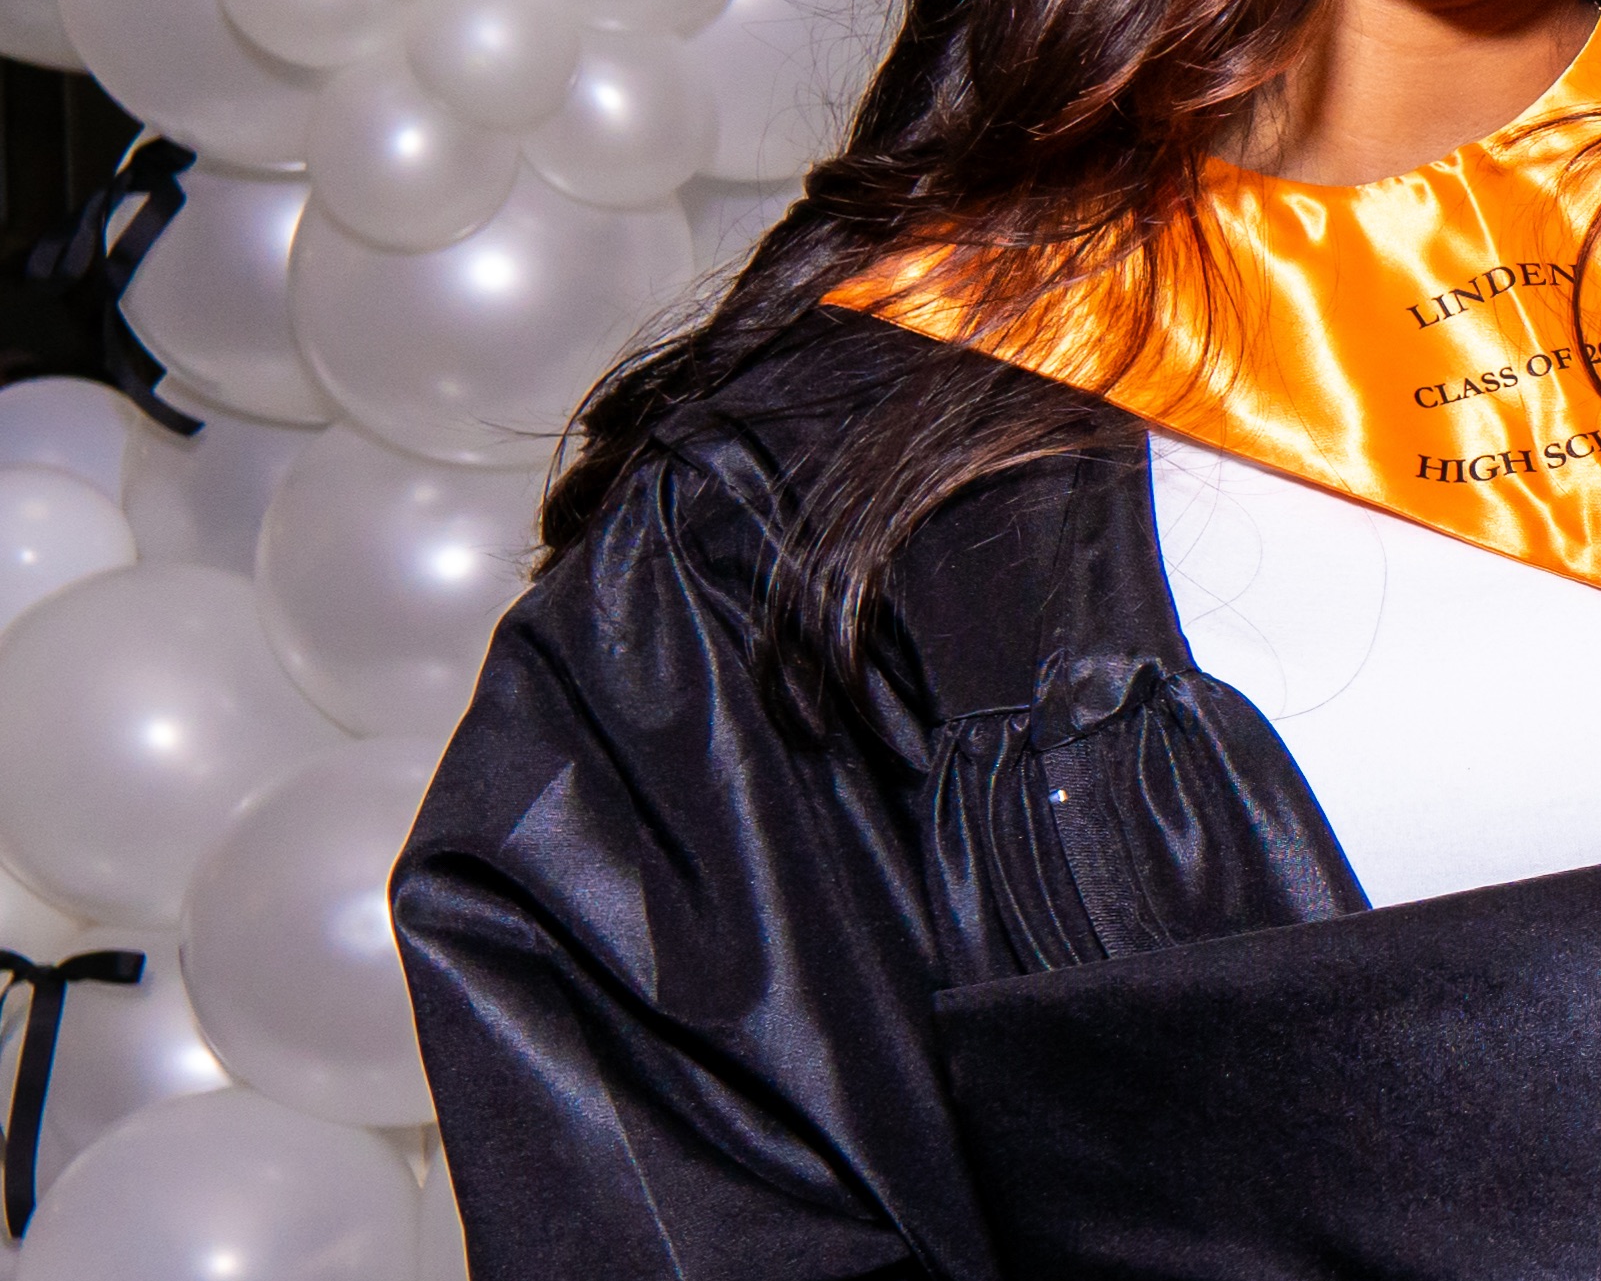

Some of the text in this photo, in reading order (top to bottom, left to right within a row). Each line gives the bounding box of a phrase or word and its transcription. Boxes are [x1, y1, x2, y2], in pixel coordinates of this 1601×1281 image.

[1405, 262, 1578, 329] LINDEN
[1413, 366, 1519, 409] CLASS
[1525, 347, 1573, 378] OF
[1415, 449, 1538, 484] HIGH
